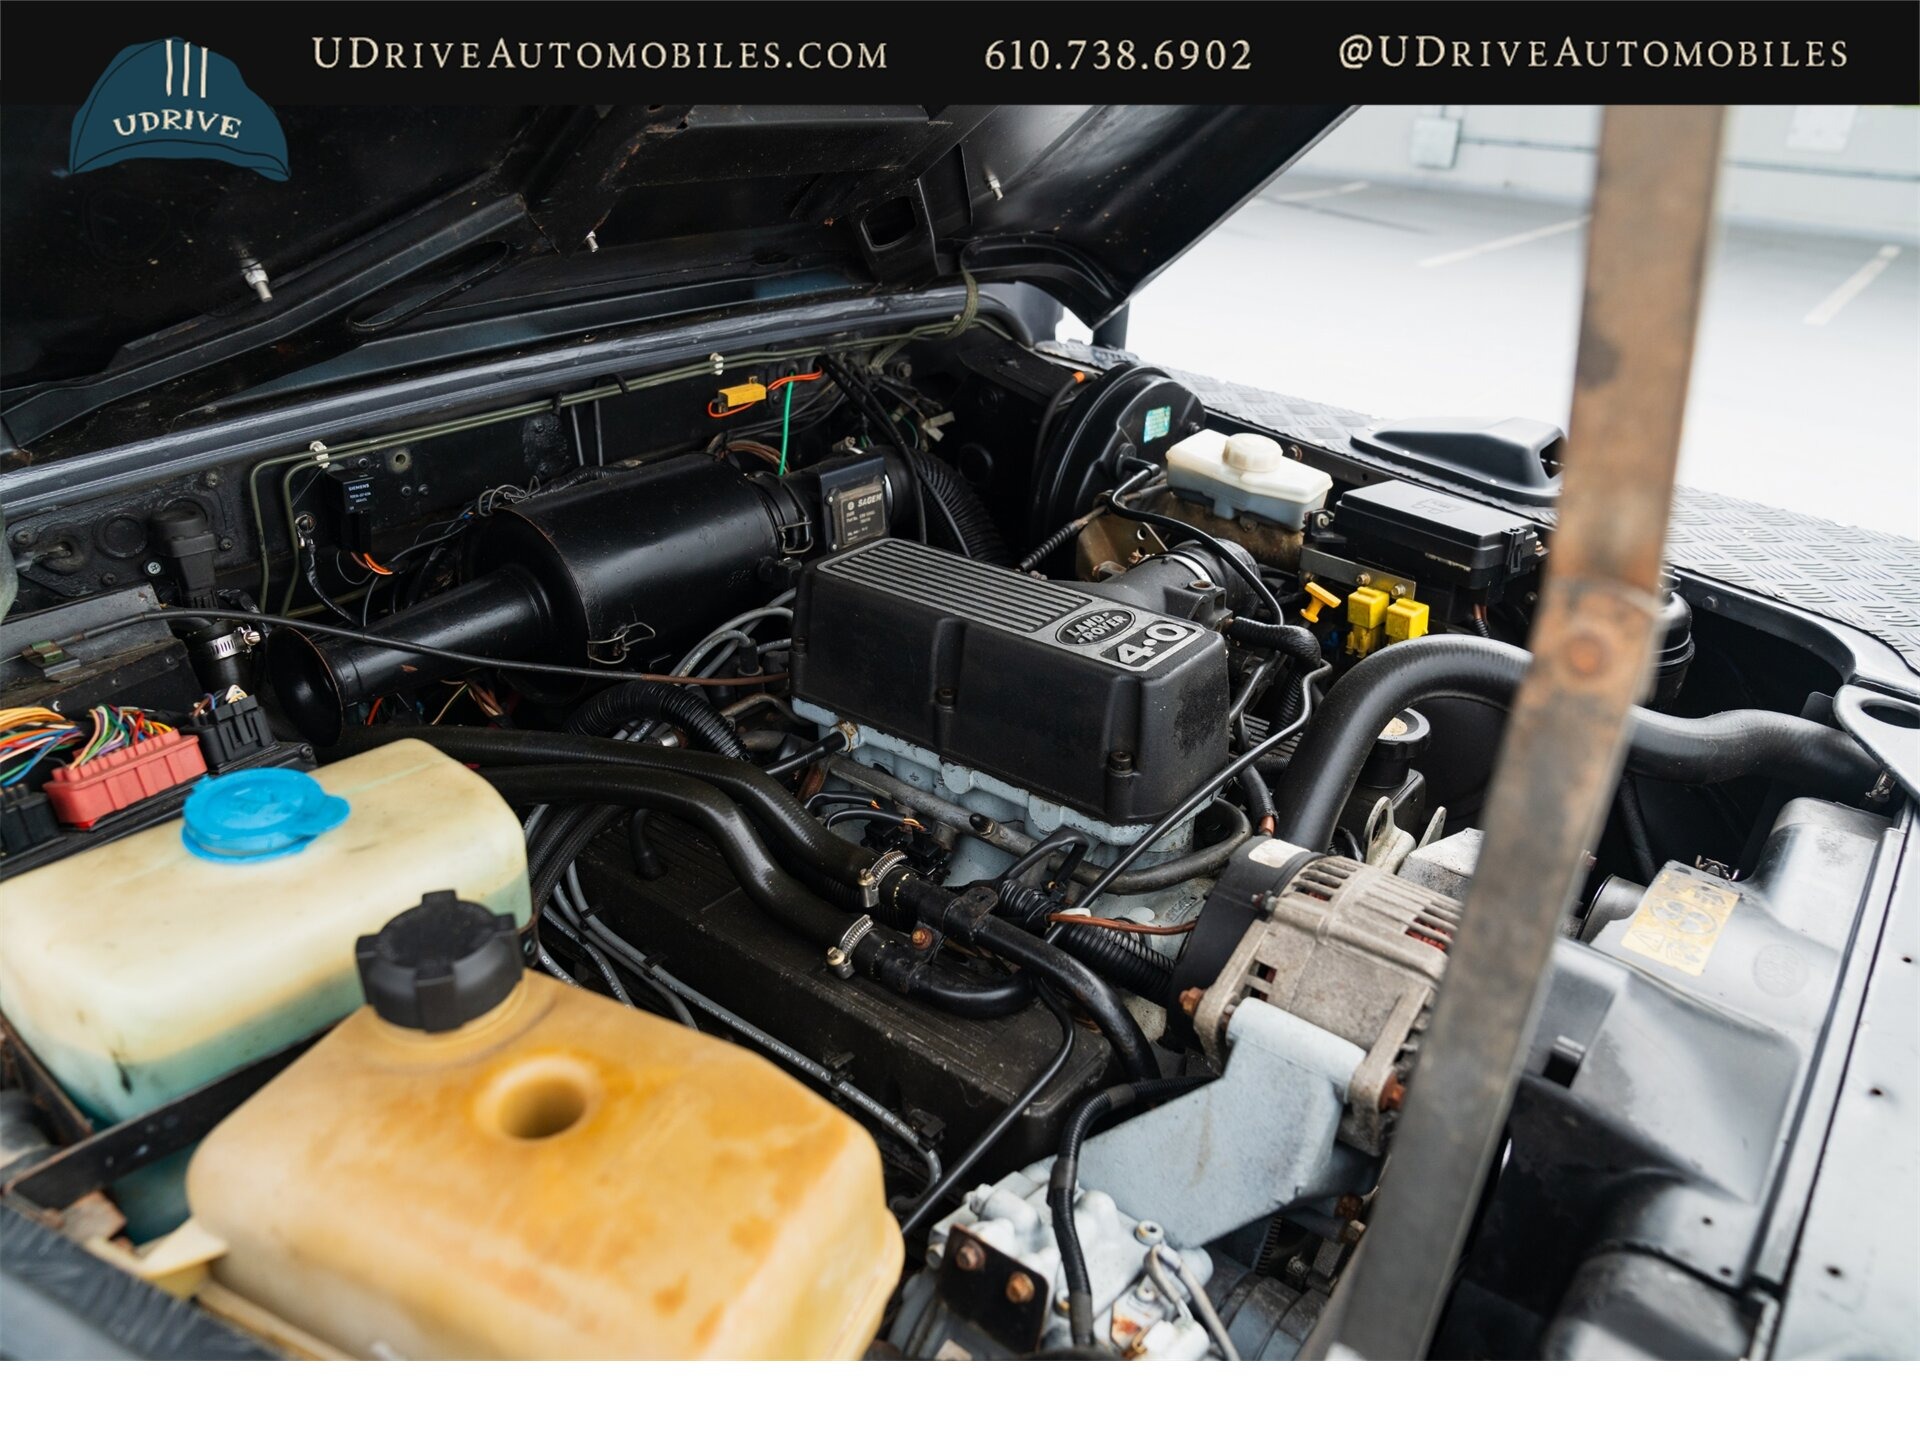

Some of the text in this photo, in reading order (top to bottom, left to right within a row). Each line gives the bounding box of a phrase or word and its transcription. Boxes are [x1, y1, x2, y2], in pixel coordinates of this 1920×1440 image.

[858, 493, 883, 507] SAGEM
[1066, 612, 1105, 638] LAND
[1083, 615, 1128, 643] ROVER
